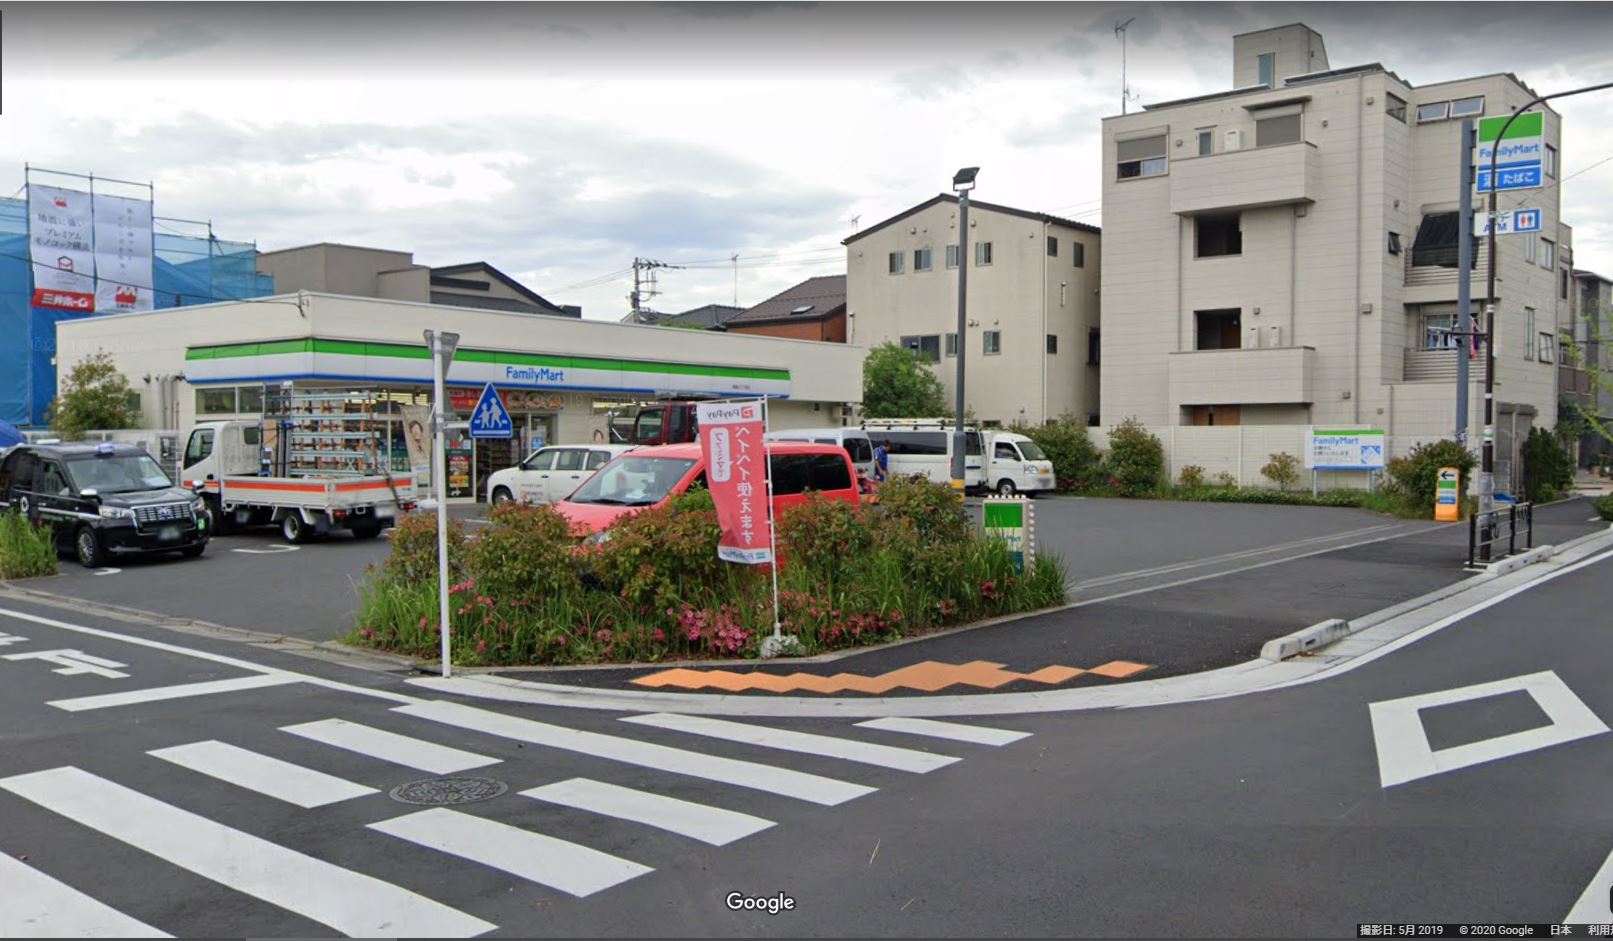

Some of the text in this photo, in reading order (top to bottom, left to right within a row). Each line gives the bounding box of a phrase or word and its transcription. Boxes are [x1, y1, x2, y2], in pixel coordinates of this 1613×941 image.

[1503, 171, 1535, 185] たばこ
[1483, 223, 1507, 232] AM
[41, 293, 89, 308] 三井ホーム
[506, 366, 564, 384] FamilyMart
[1313, 437, 1359, 446] FamilyMart
